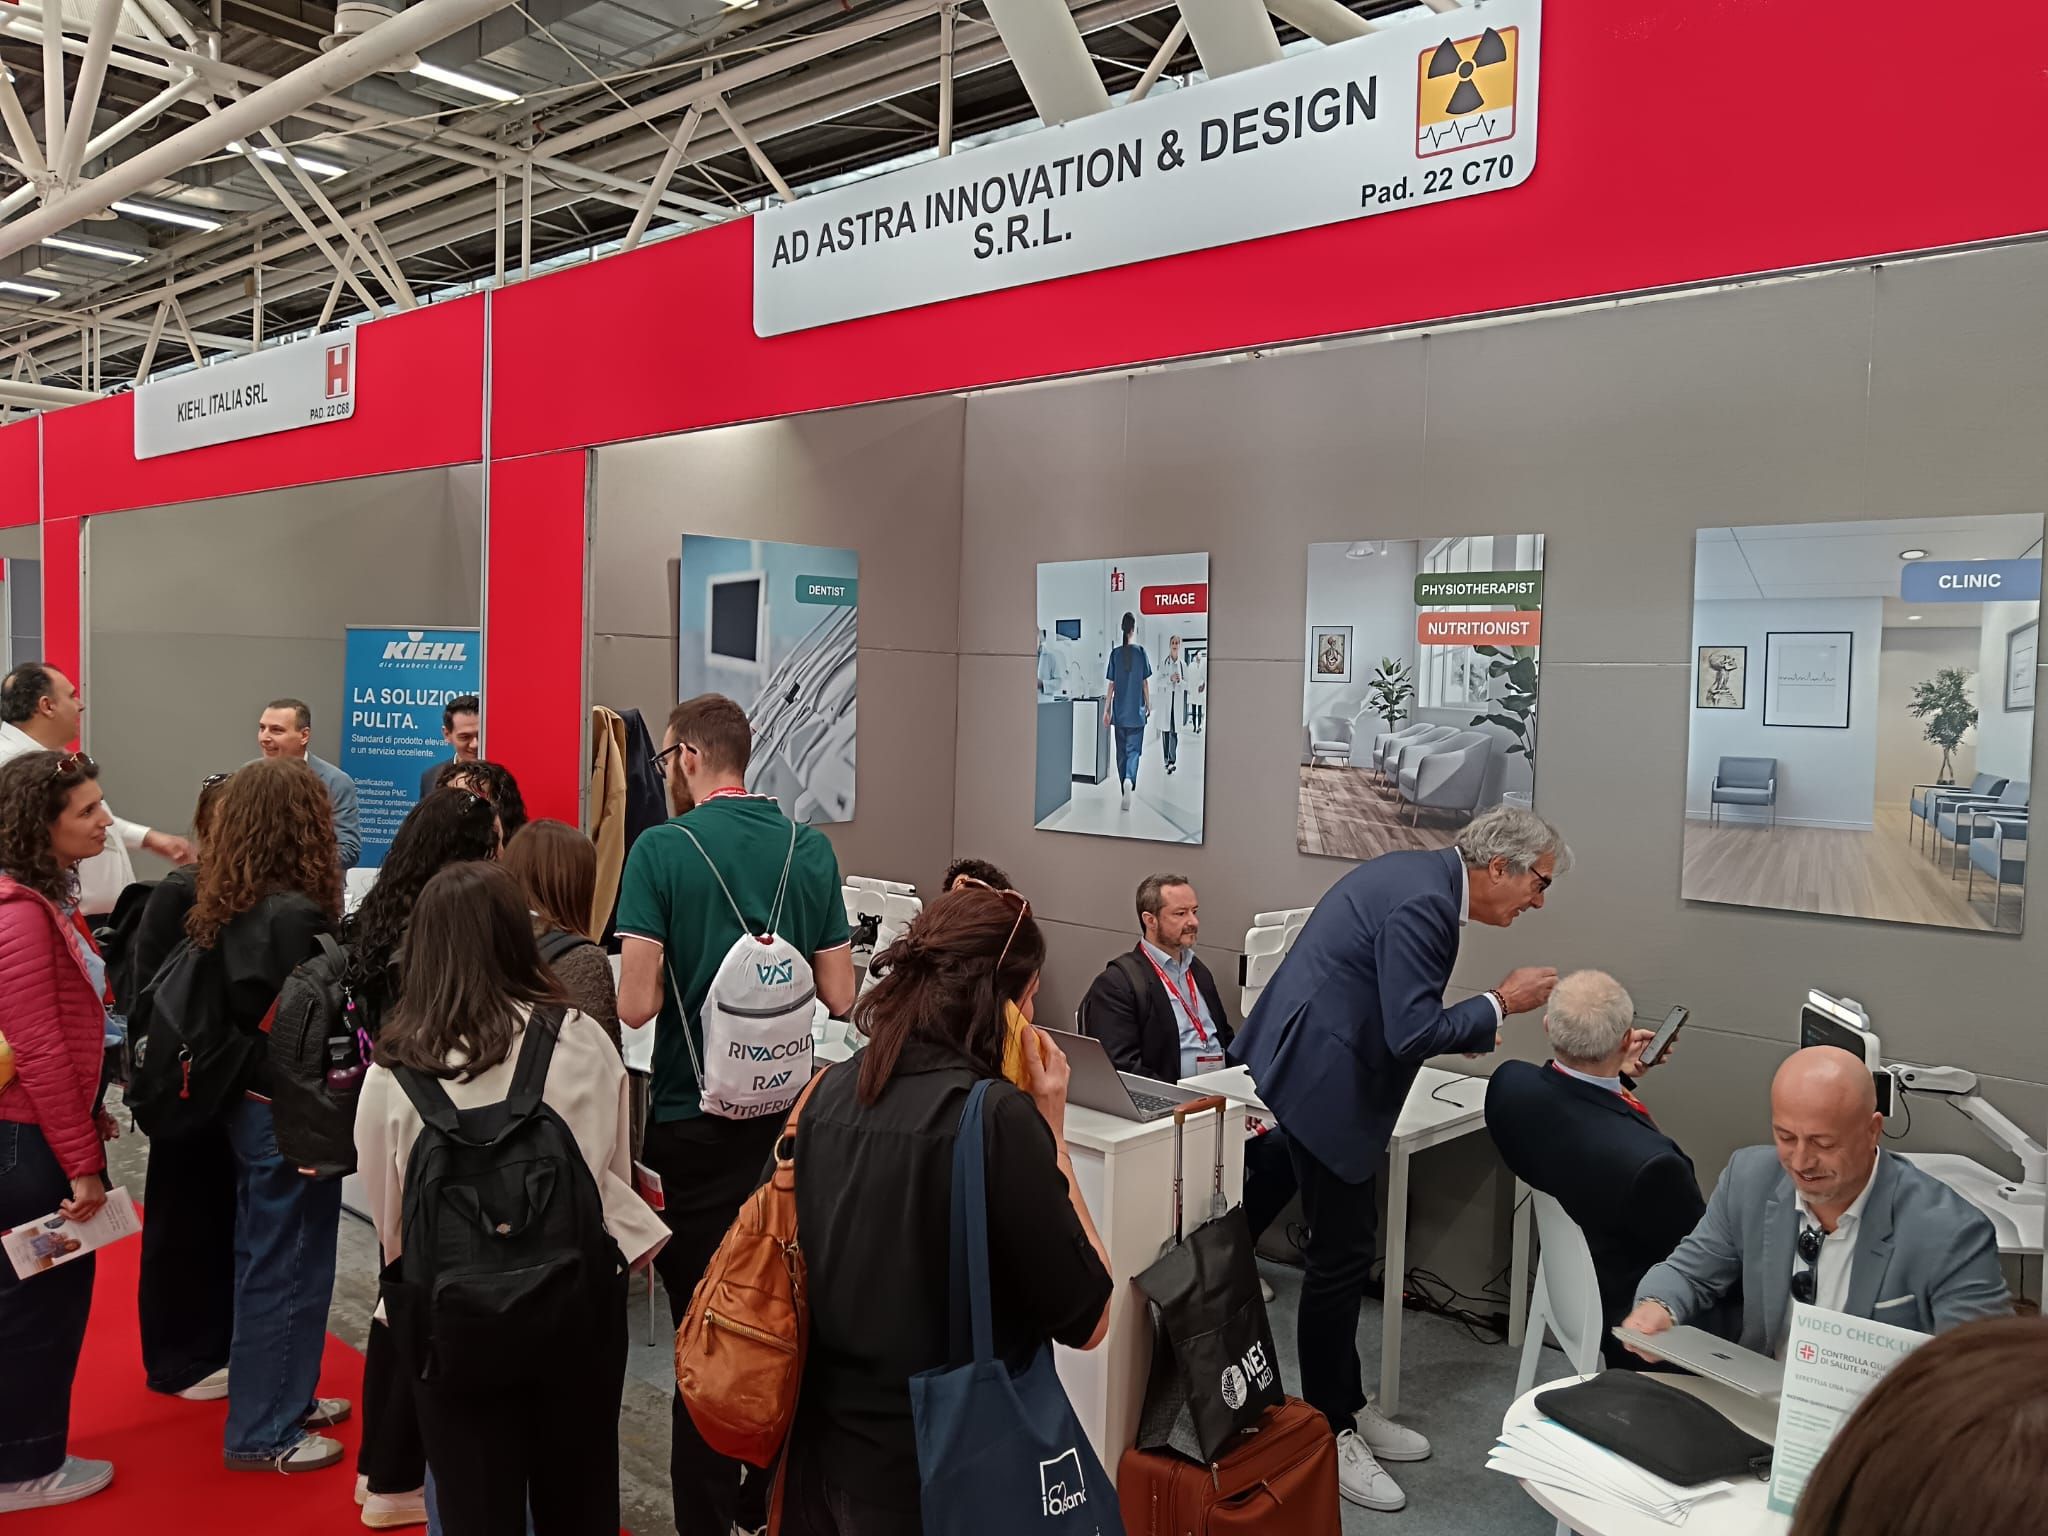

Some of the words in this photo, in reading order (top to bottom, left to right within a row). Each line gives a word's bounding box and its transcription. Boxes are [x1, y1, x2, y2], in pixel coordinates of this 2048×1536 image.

[772, 230, 809, 268] AD
[816, 201, 916, 257] ASTRA
[925, 139, 1142, 229] INNOVATION
[1157, 129, 1185, 171] &
[1200, 75, 1377, 162] DESIGN
[1361, 176, 1415, 207] Pad.
[1423, 167, 1453, 195] 22
[1462, 154, 1514, 186] C70
[973, 208, 1072, 260] S.R.L.
[177, 398, 206, 422] KIEHL
[209, 388, 243, 415] ITALIA
[245, 382, 268, 407] SRL
[310, 408, 325, 419] PAD.
[327, 405, 336, 417] 22
[1421, 582, 1535, 595] PHYSIOTHERAPIST
[1938, 573, 2002, 588] CLINIC
[808, 584, 845, 597] DENTIST
[1154, 592, 1196, 606] TRIAGE
[1428, 621, 1530, 635] NUTRITIONIST
[382, 641, 468, 661] KIEHL
[353, 687, 376, 704] LA
[380, 688, 480, 706] SOLUZIO
[352, 711, 419, 729] PULITA.
[351, 734, 384, 743] Standard
[385, 735, 393, 743] di
[393, 736, 425, 746] prodotto
[368, 746, 397, 755] servizio
[752, 1070, 793, 1091] RAV
[1797, 1315, 1842, 1336] VIDEO
[1846, 1327, 1896, 1351] CHECK
[1820, 1356, 1829, 1366] DI
[1830, 1359, 1859, 1374] SALUTE
[1821, 1348, 1868, 1367] CONTROLLA
